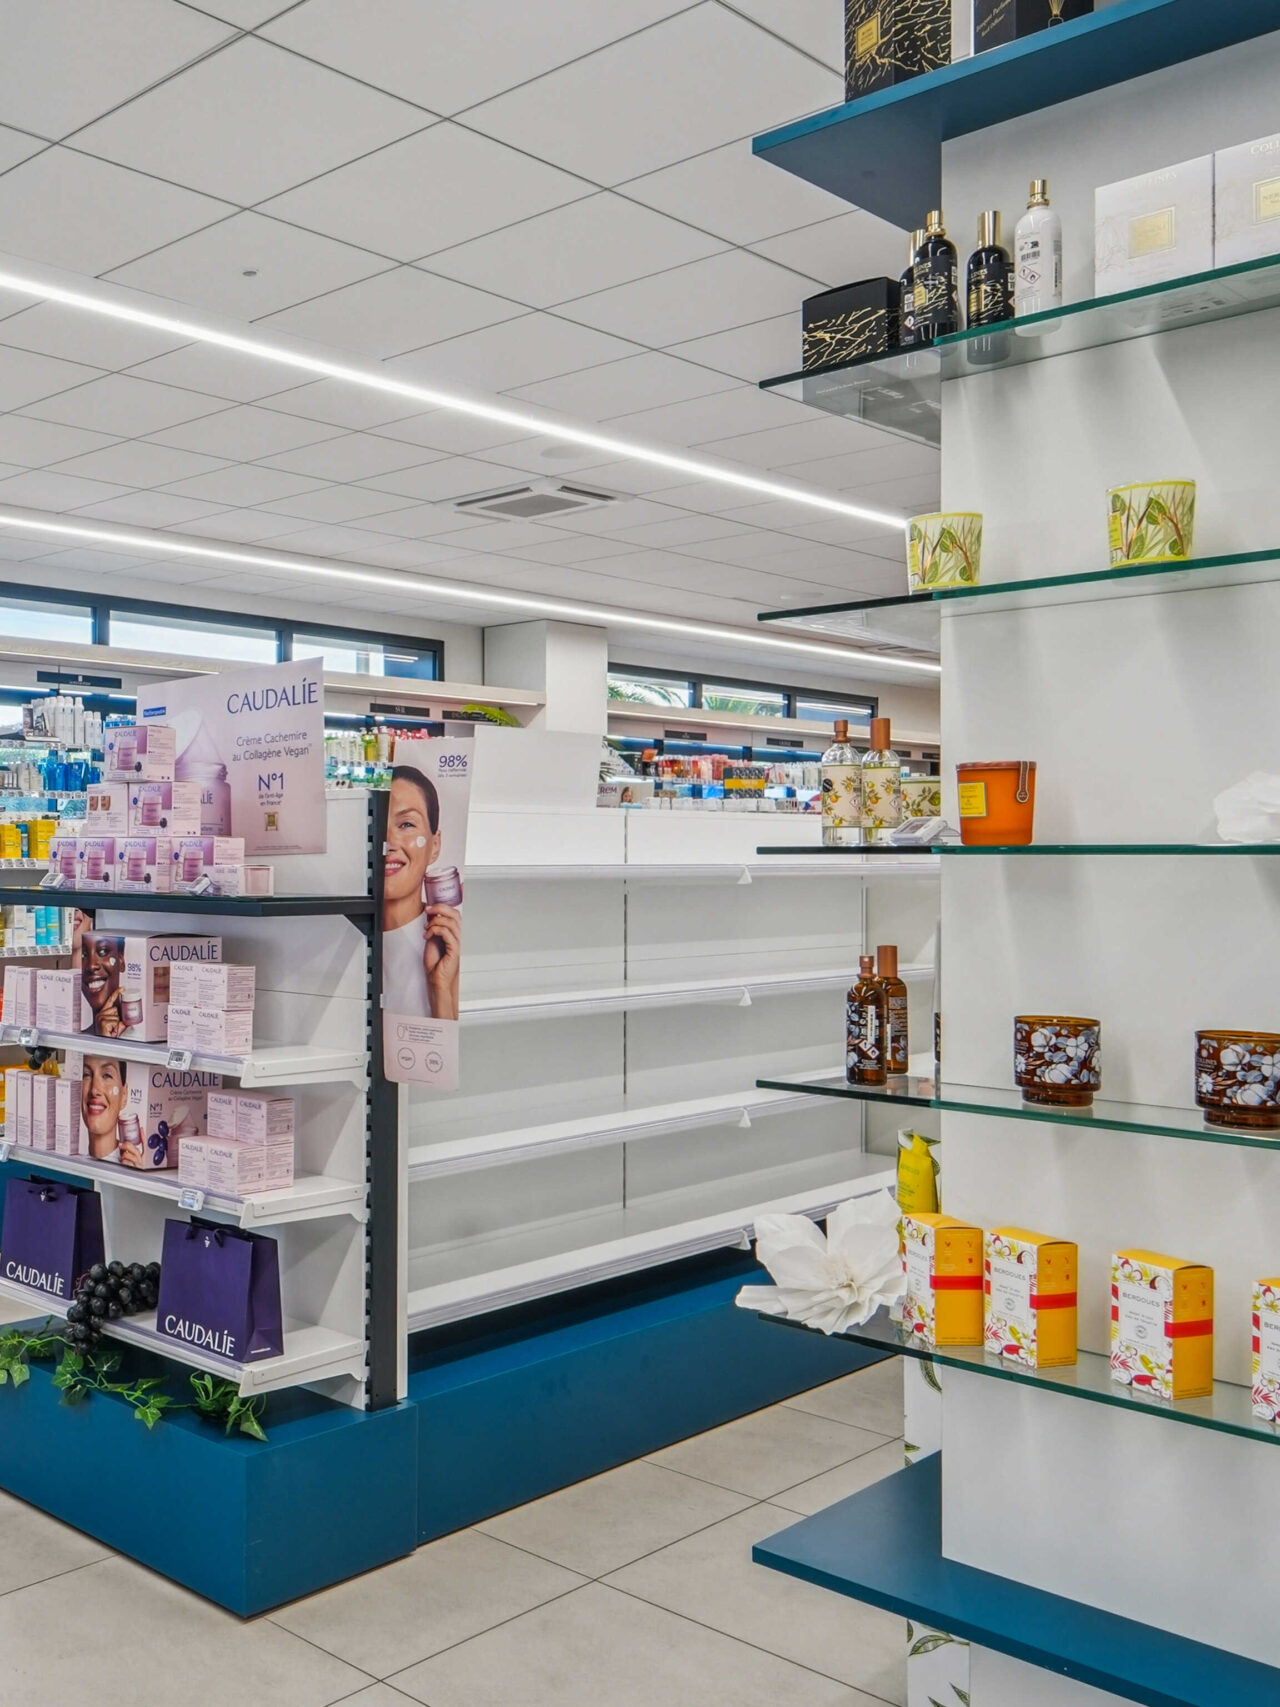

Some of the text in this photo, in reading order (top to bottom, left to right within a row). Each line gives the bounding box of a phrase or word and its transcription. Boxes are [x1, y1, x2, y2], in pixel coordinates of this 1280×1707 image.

[236, 731, 307, 747] Crème Cachemire
[232, 753, 241, 762] au
[243, 748, 282, 761] Collagène
[439, 755, 468, 768] 98%
